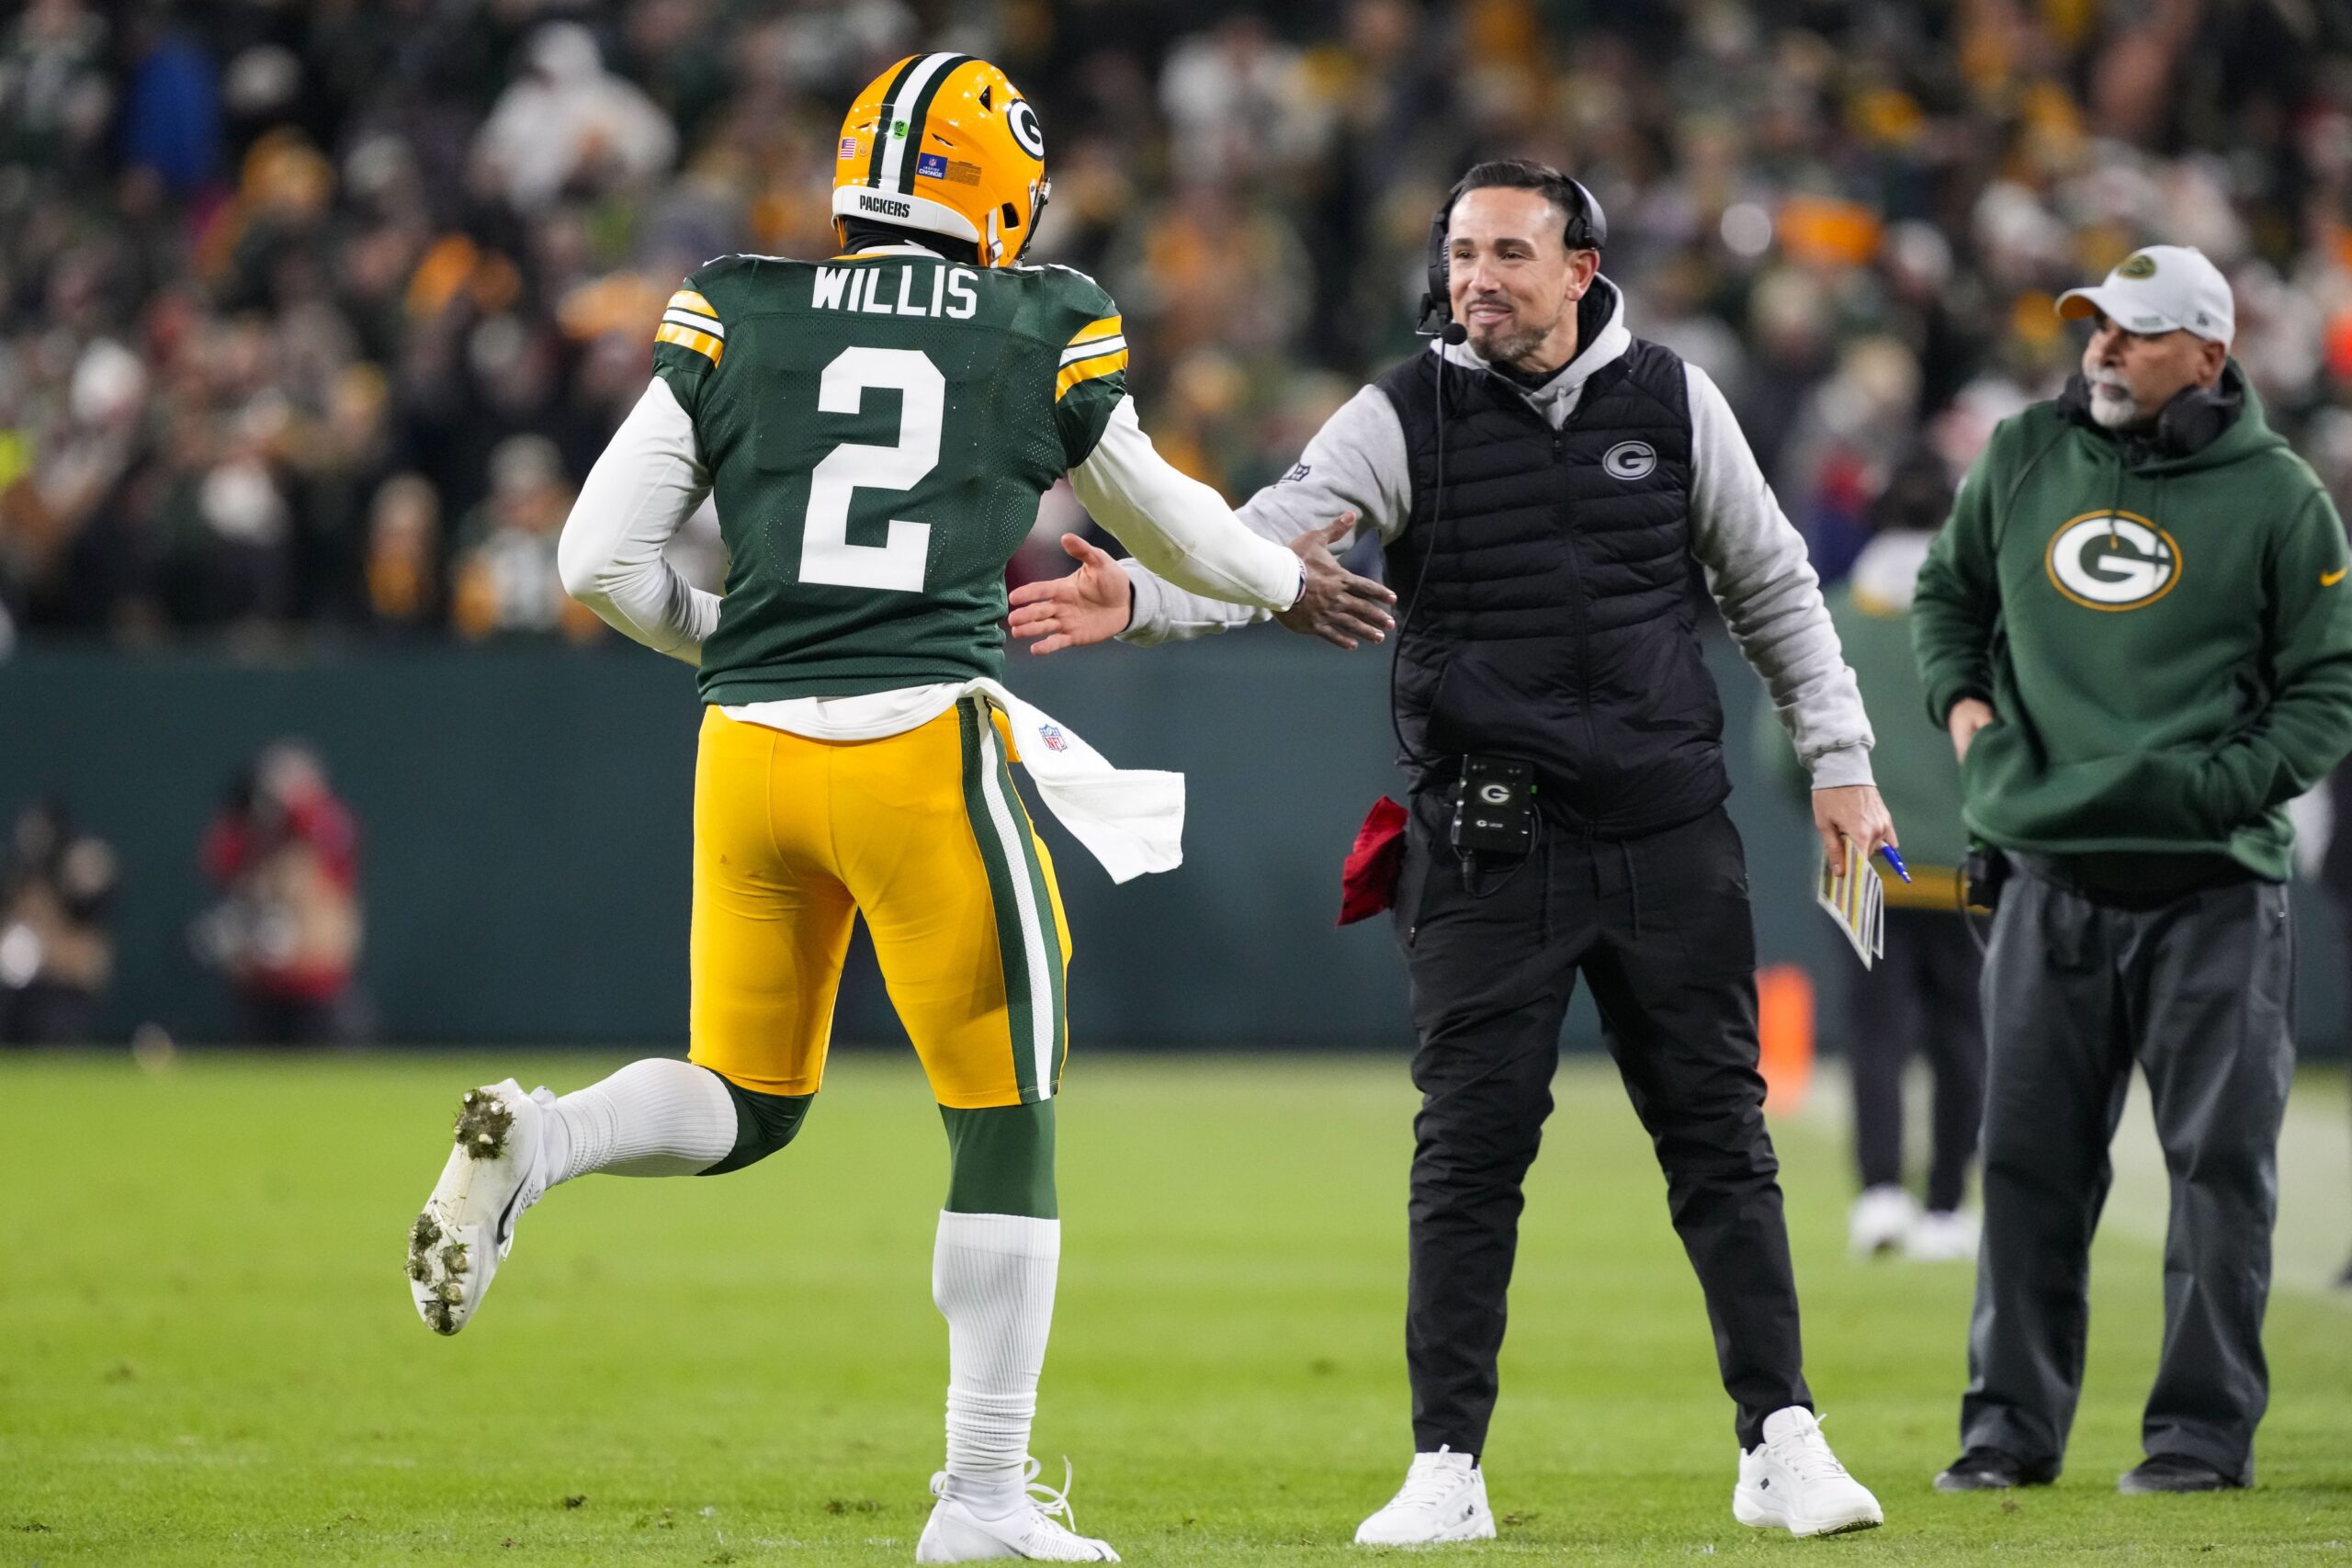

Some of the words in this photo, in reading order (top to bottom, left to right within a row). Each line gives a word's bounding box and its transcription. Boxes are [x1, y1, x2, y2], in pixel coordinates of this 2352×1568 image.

[860, 194, 910, 219] PACKERS
[811, 265, 978, 319] WILLIS
[798, 346, 946, 593] 2
[1606, 444, 1655, 477] G
[2052, 516, 2173, 604] G
[1480, 784, 1510, 804] G
